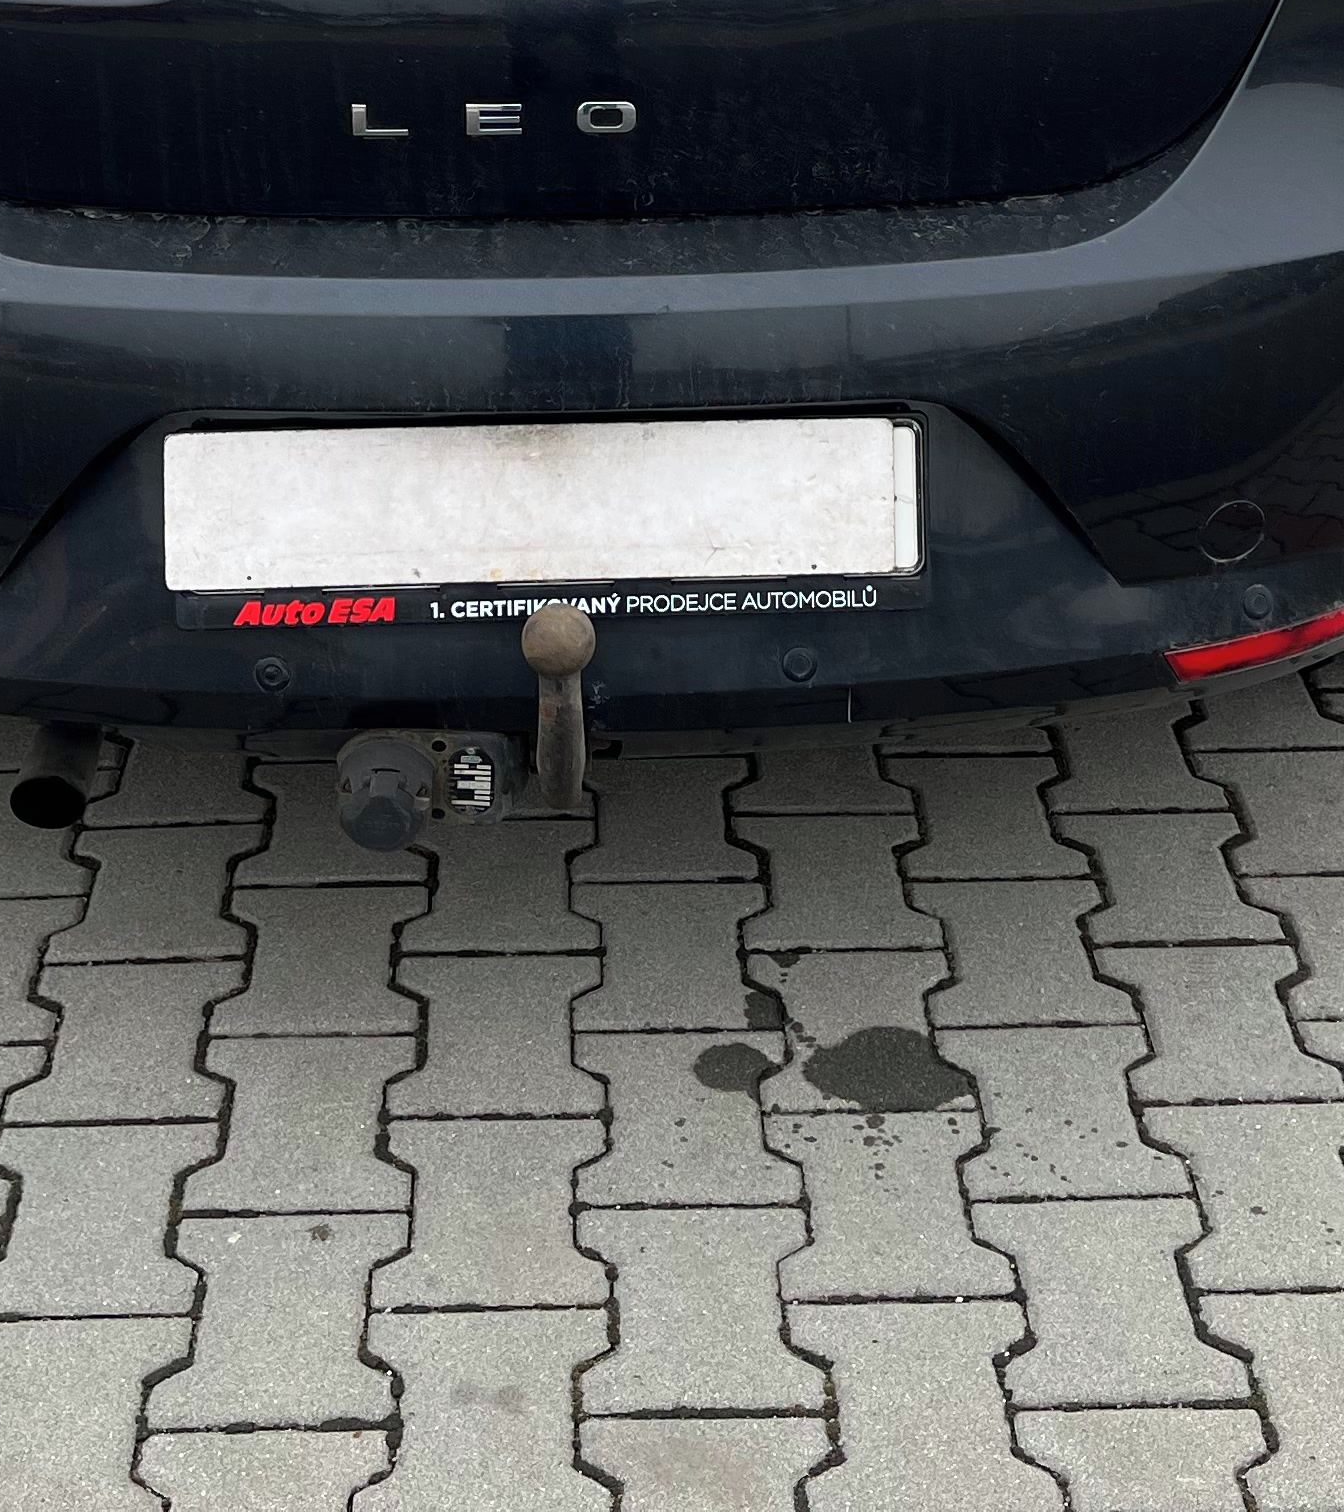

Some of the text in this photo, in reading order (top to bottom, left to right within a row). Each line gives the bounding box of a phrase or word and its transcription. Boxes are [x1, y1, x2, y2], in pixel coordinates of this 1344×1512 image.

[233, 585, 877, 626] Auto ESA 1. CERTIFIKANÝ PRODEJCE AUTOMOBILŮ
